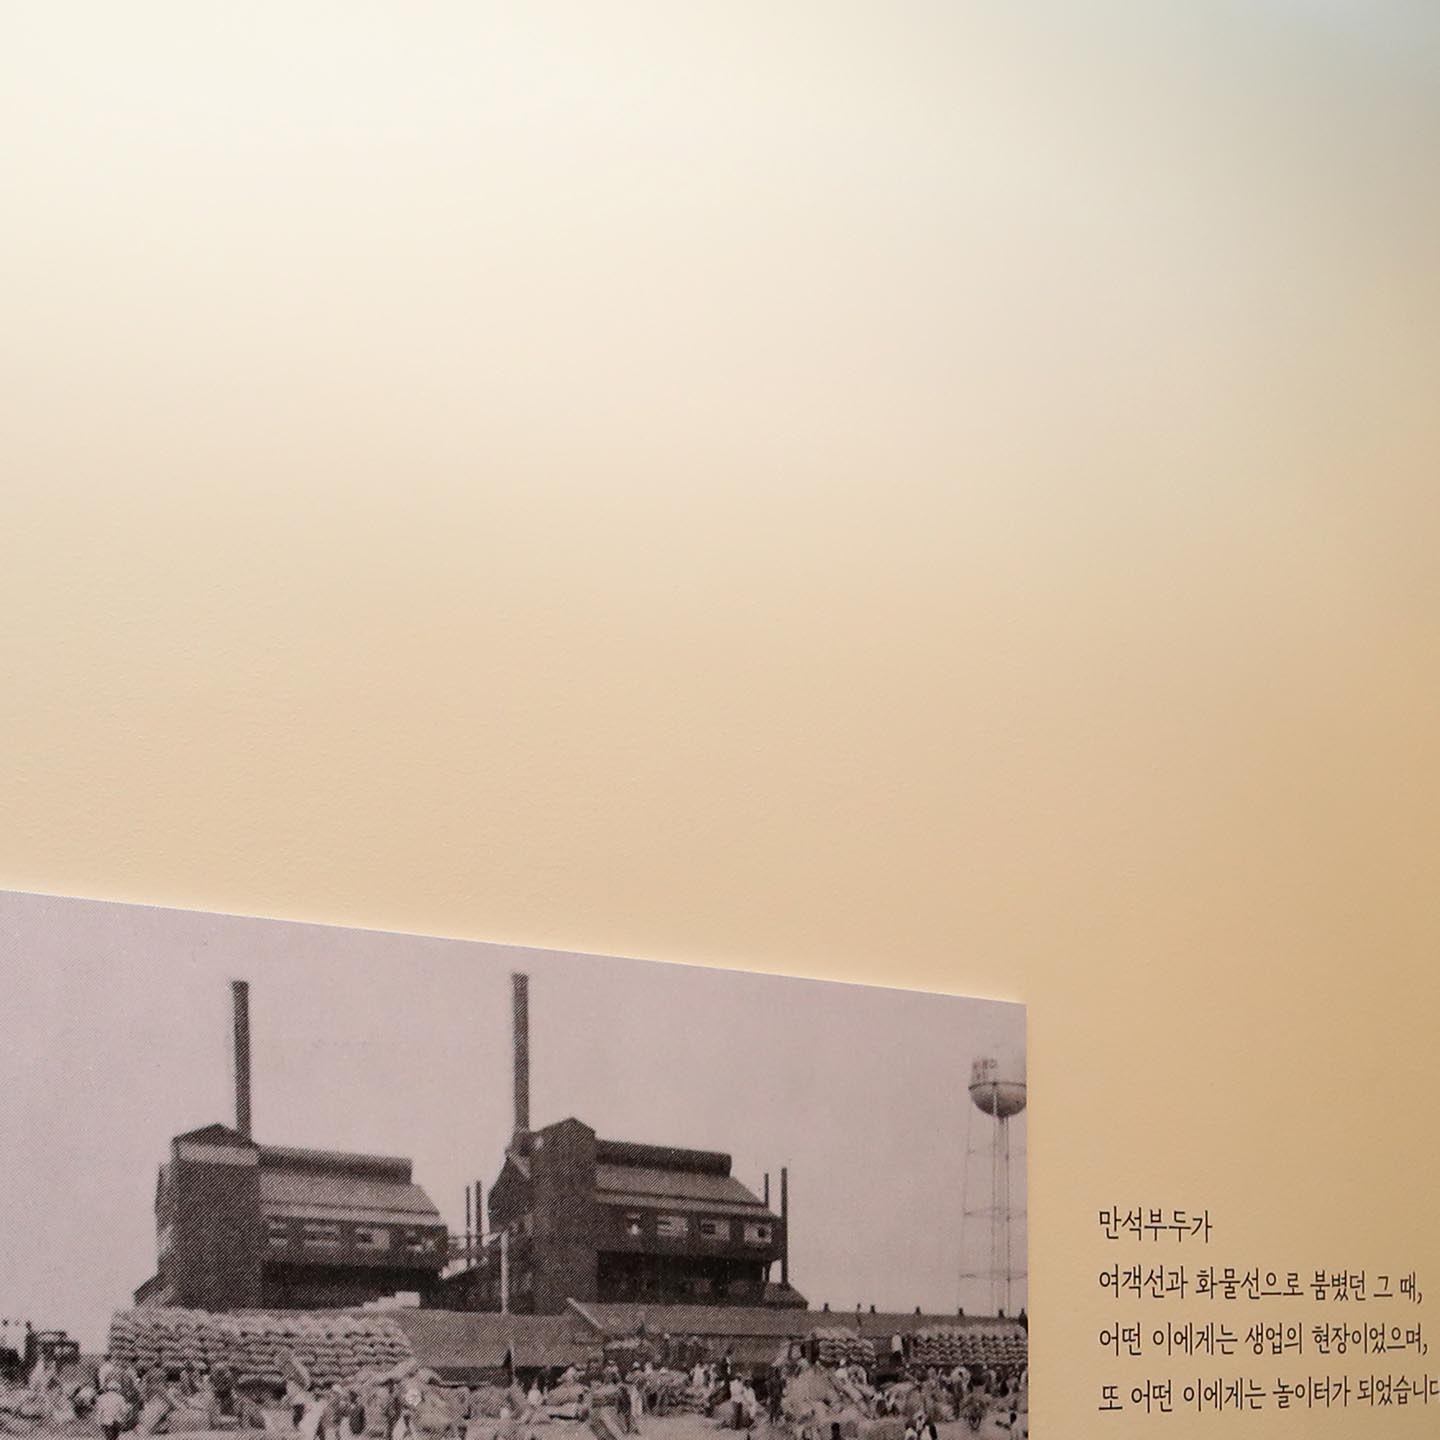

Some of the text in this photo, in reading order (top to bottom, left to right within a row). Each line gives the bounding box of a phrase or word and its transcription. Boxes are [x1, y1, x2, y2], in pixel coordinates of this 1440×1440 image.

[1098, 1204, 1214, 1245] 만석부두가
[1098, 1263, 1423, 1305] 여객선과 화물선으로 붐볐던 그 때,
[1099, 1321, 1428, 1358] 어떤 이에게는 생업의 현장이었으며,
[1097, 1385, 1124, 1412] 또
[1130, 1378, 1174, 1415] 어떤
[1182, 1376, 1267, 1413] 이에게는
[1271, 1374, 1352, 1410] 놀이터가
